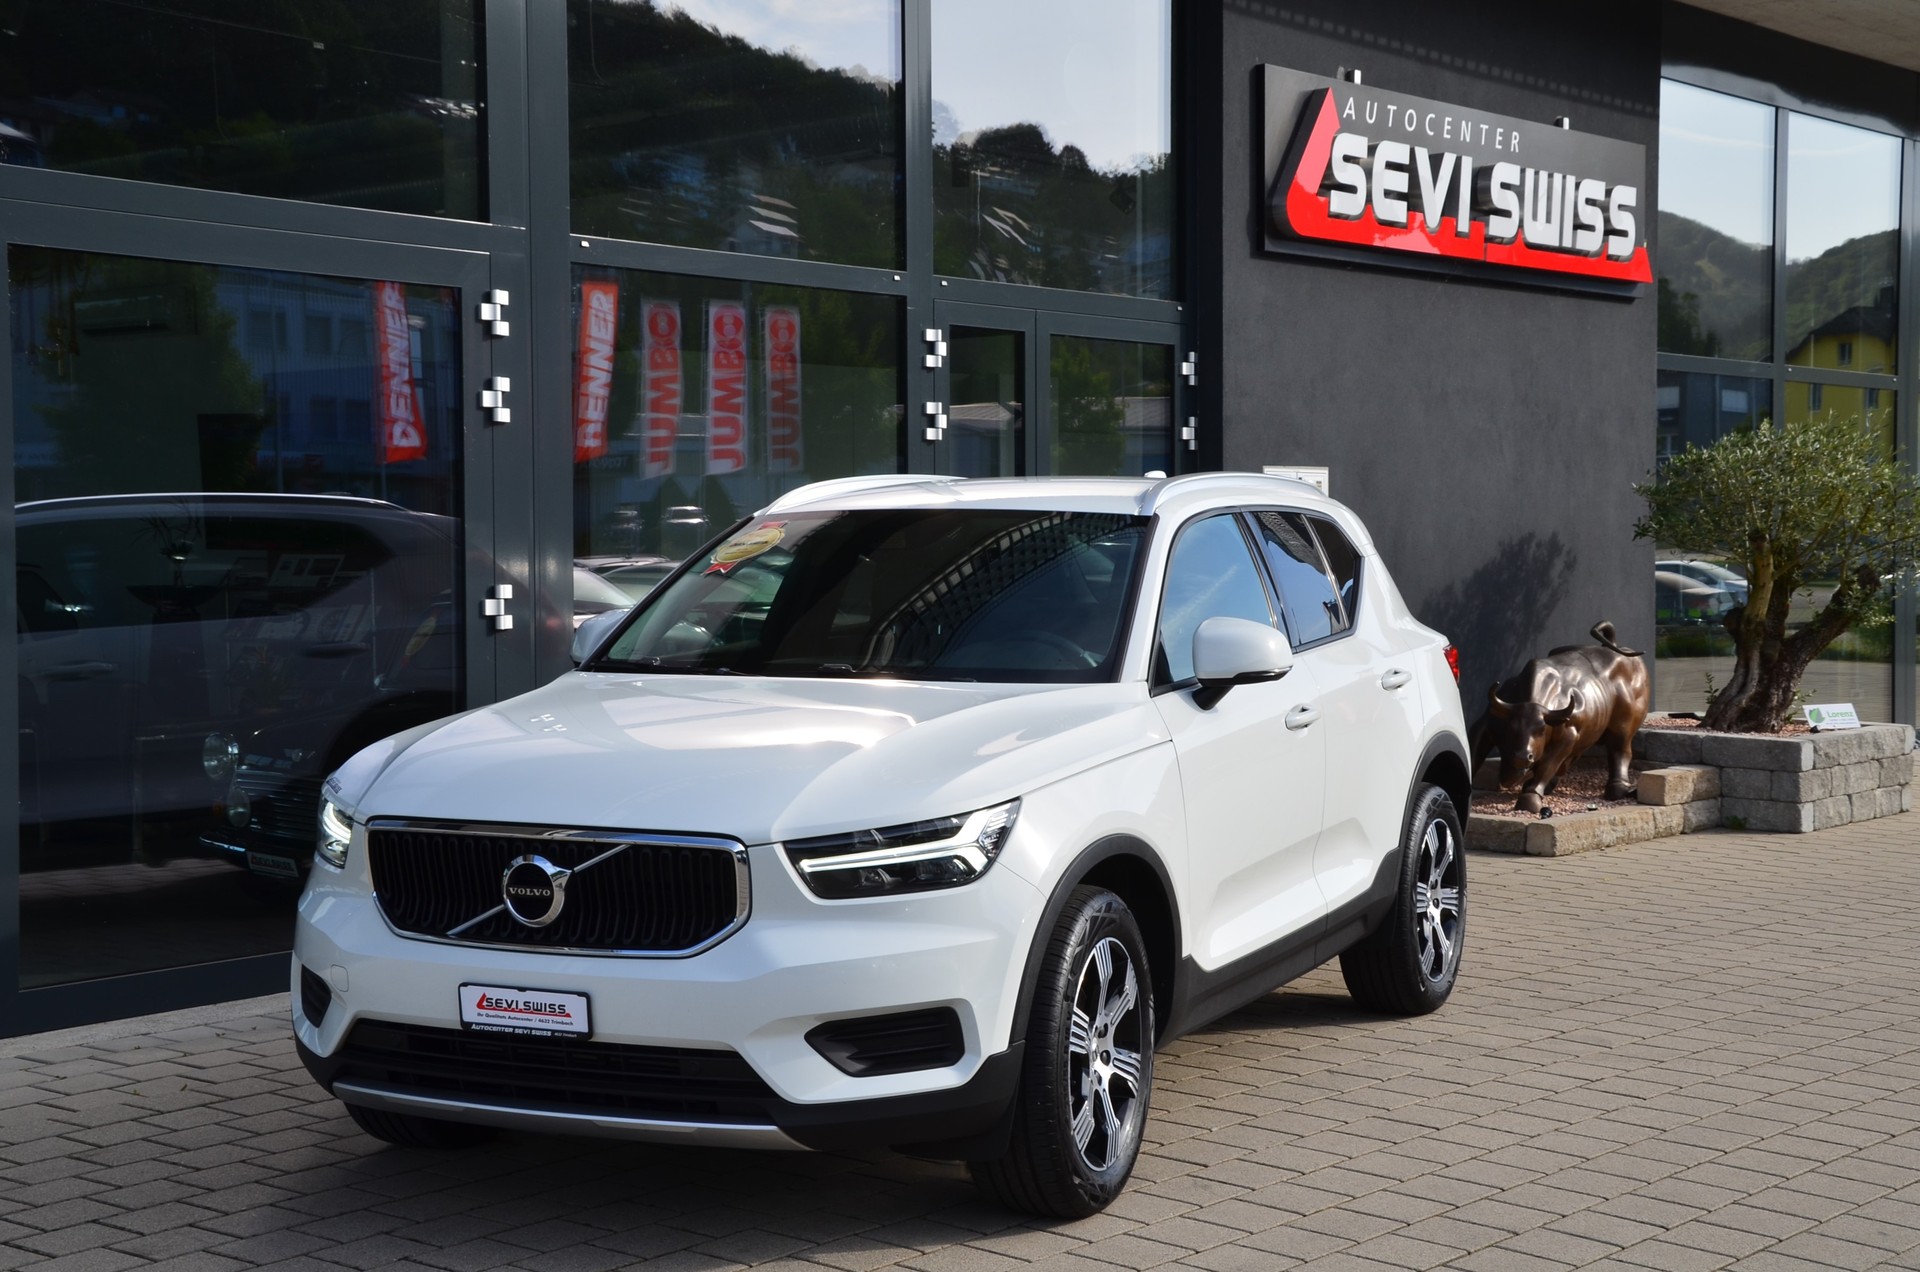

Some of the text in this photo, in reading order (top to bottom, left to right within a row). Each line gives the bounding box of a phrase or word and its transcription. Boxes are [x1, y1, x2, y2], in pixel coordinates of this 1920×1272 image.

[1343, 96, 1521, 153] AUTOCENTER
[1328, 131, 1638, 258] SEVI SWISS
[647, 304, 681, 470] JUMBO
[711, 305, 746, 469] JUMBO
[769, 309, 800, 468] JUMBO
[509, 887, 551, 897] VOLVO
[471, 1023, 514, 1033] AUTOCENTER
[485, 997, 566, 1014] SEVI SWISS
